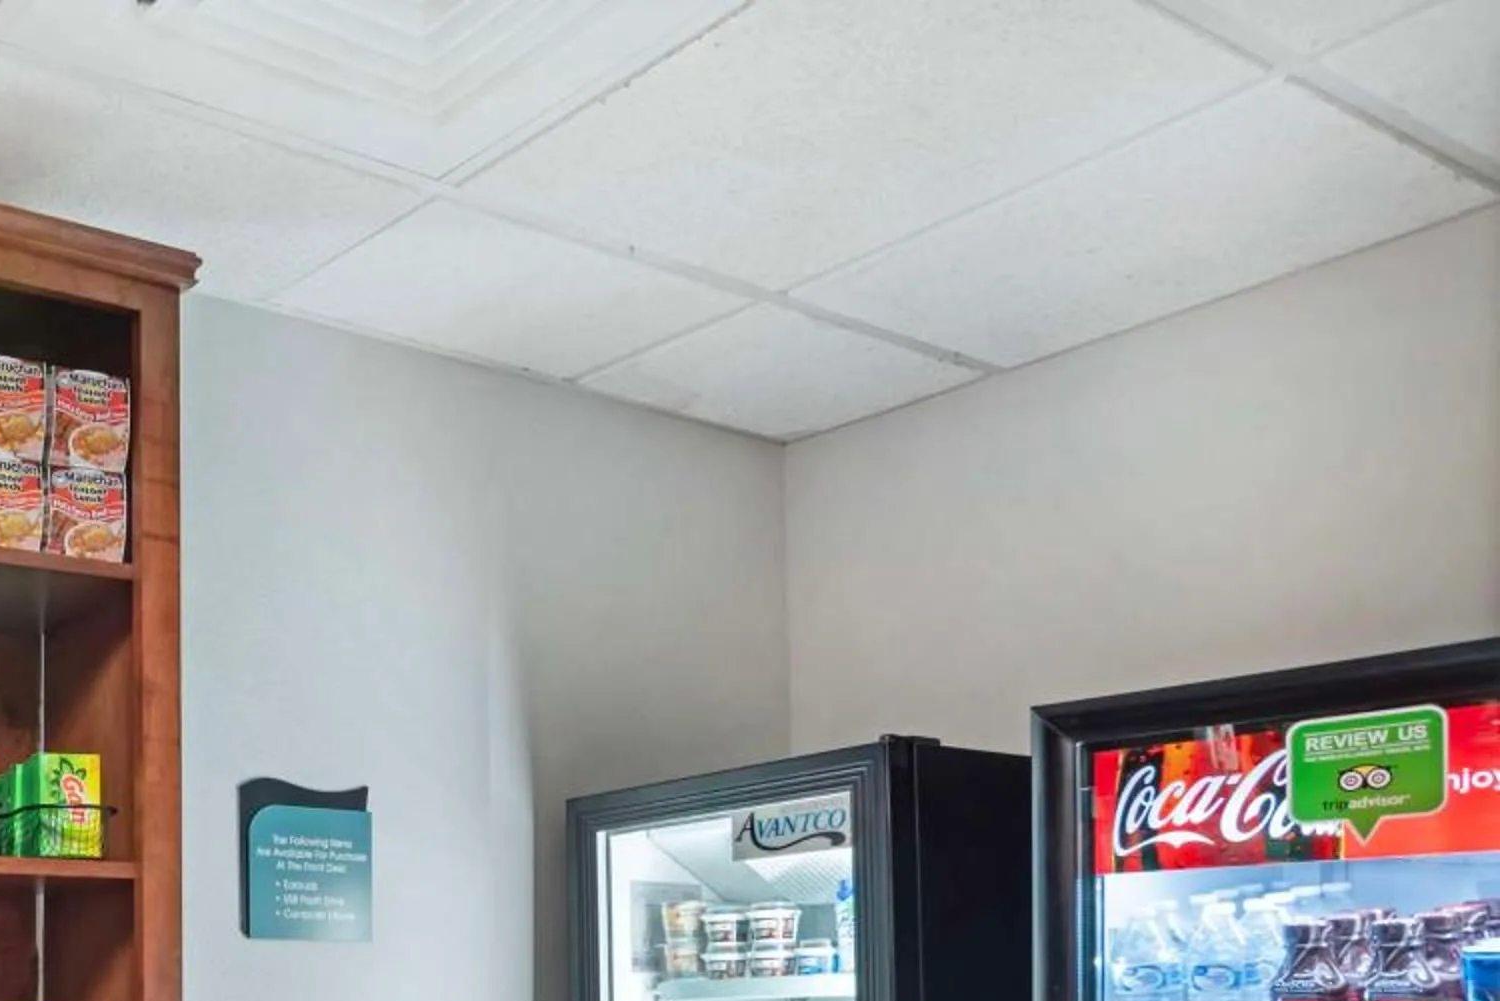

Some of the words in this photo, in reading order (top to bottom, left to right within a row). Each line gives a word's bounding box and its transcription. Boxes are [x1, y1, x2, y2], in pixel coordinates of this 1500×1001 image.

[1305, 729, 1388, 752] REVIEW
[1398, 724, 1428, 741] US
[1447, 768, 1500, 794] njoy
[1114, 748, 1343, 857] Coca-Co
[735, 809, 847, 846] AVANTCO
